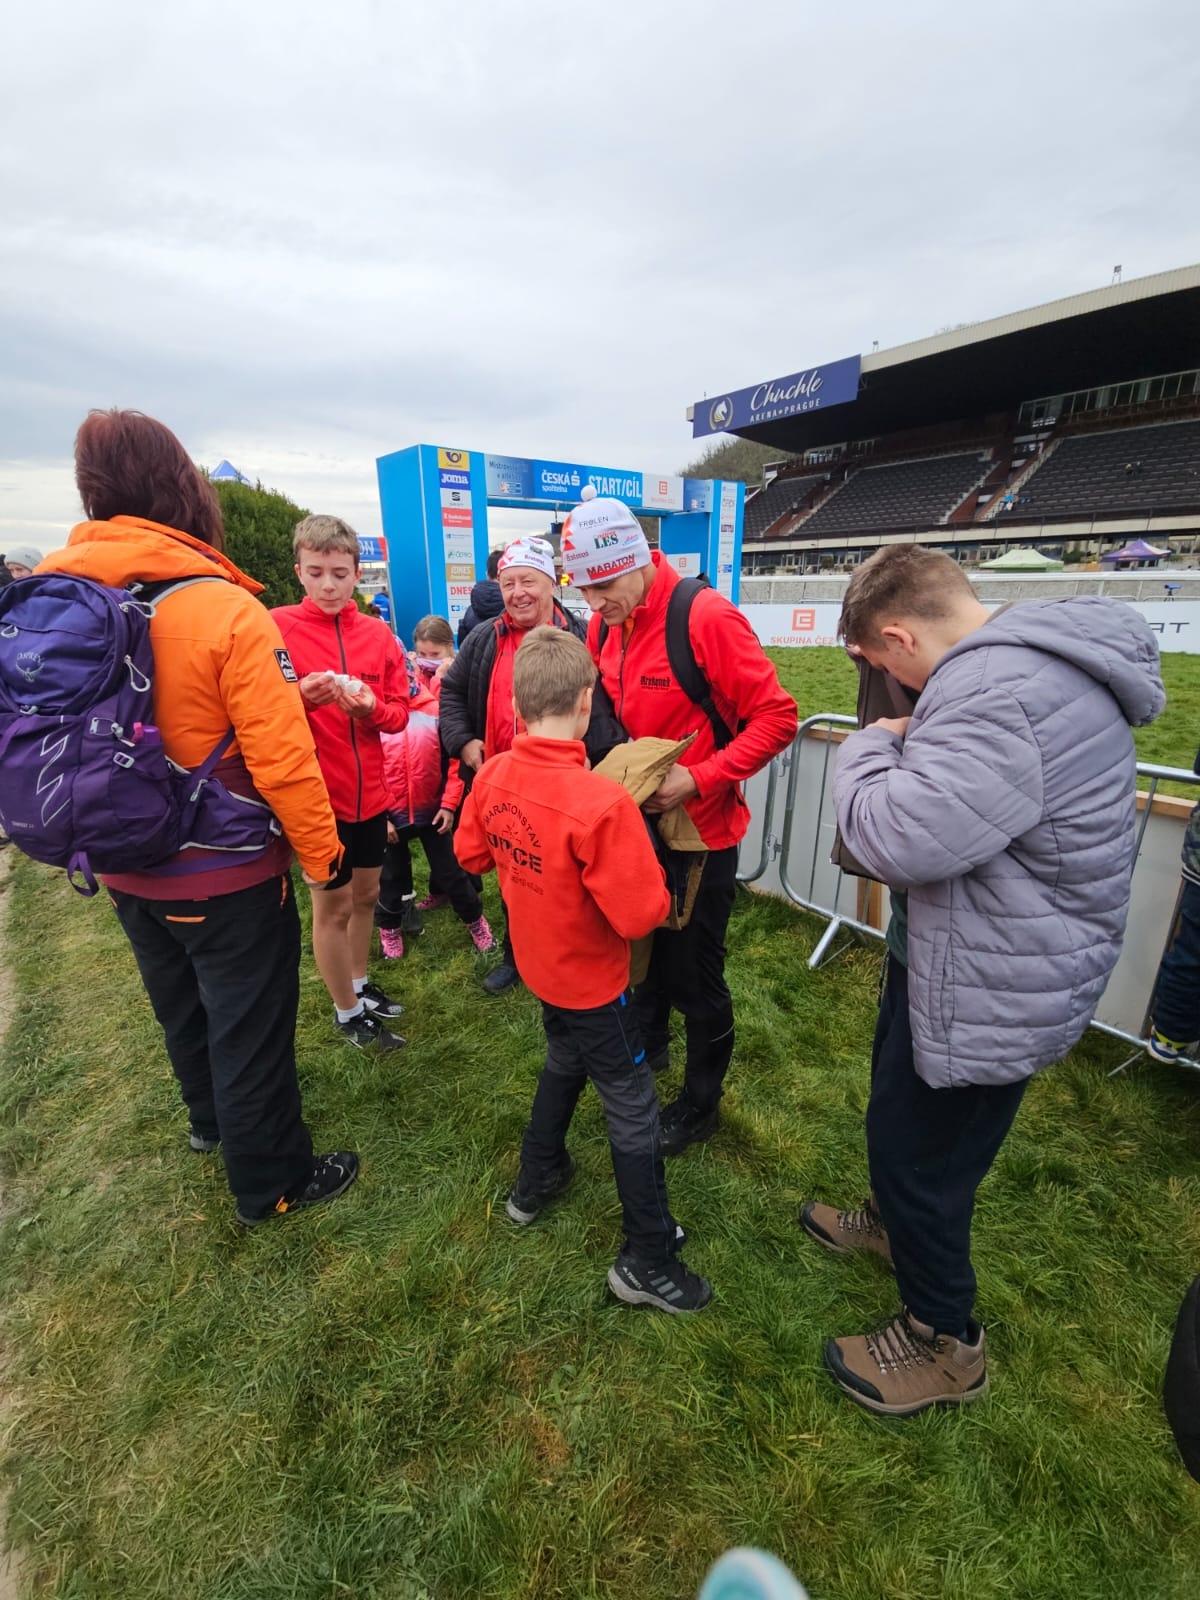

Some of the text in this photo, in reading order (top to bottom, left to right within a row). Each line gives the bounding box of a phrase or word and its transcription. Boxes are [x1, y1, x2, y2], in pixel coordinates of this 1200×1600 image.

[751, 370, 823, 411] Chuchle
[750, 398, 820, 423] ARENA PRAGUE
[541, 469, 570, 486] ČESKÁ
[358, 540, 375, 556] ON
[594, 534, 619, 549] LES
[586, 552, 636, 576] MARATON
[450, 586, 473, 596] DNES
[1148, 622, 1190, 634] AT
[770, 634, 834, 646] SKUPINA ČEZ
[483, 802, 541, 849] MARATONSTAV
